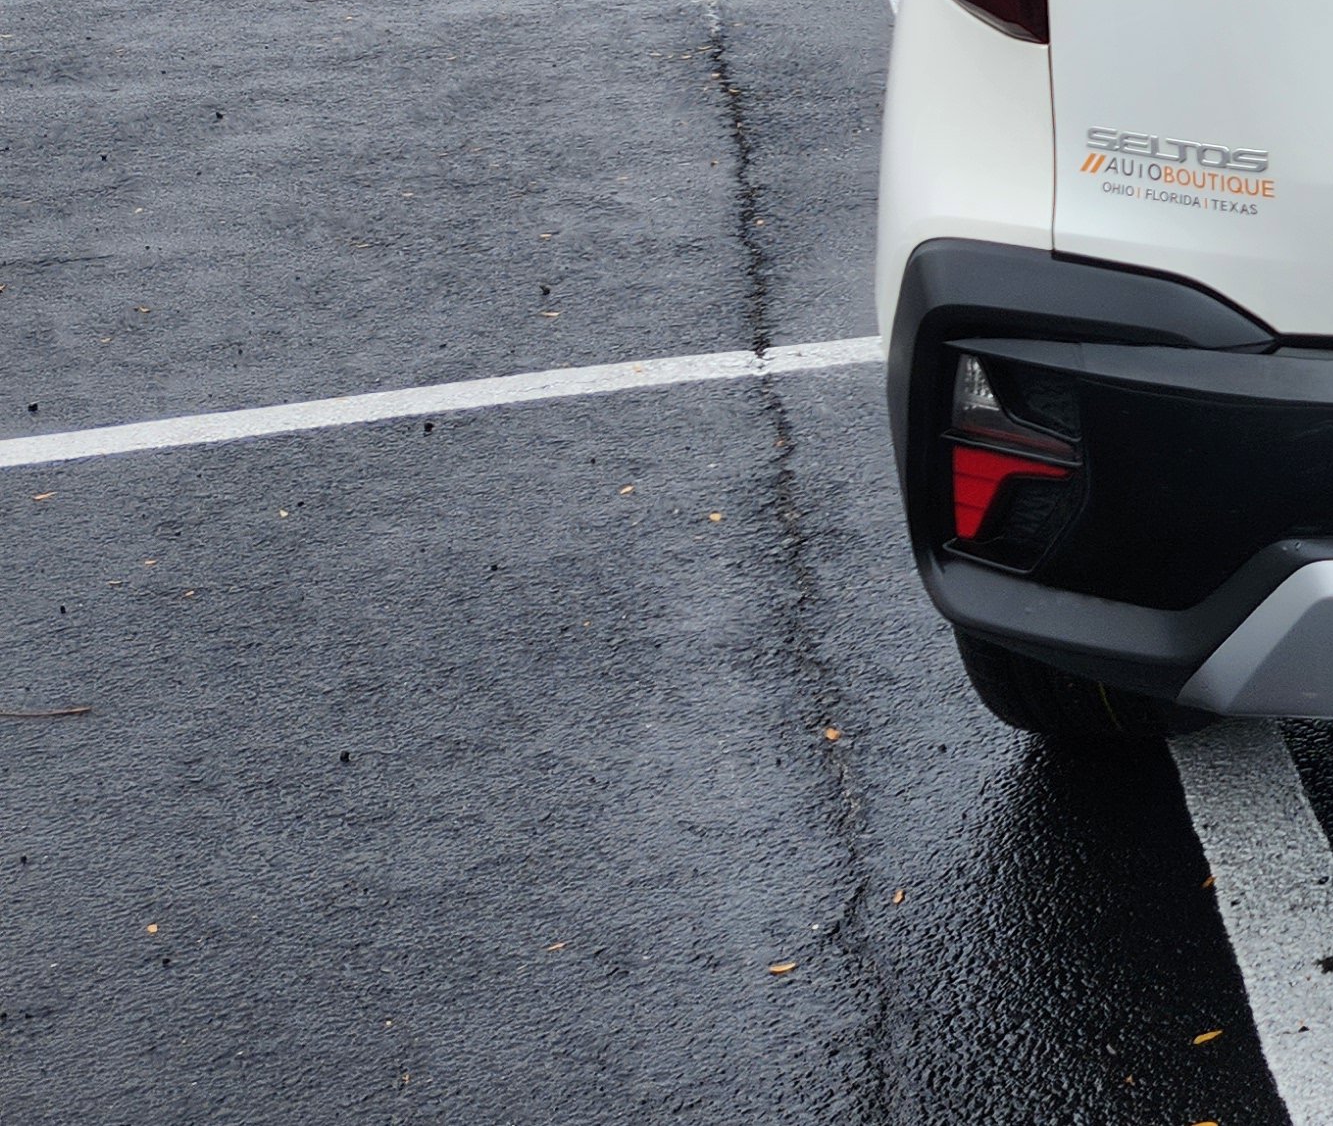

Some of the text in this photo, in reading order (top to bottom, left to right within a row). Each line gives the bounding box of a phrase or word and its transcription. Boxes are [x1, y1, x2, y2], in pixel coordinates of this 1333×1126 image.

[1086, 125, 1269, 173] SELTOS
[1102, 181, 1258, 215] OHIO FLORIDA TEXAS
